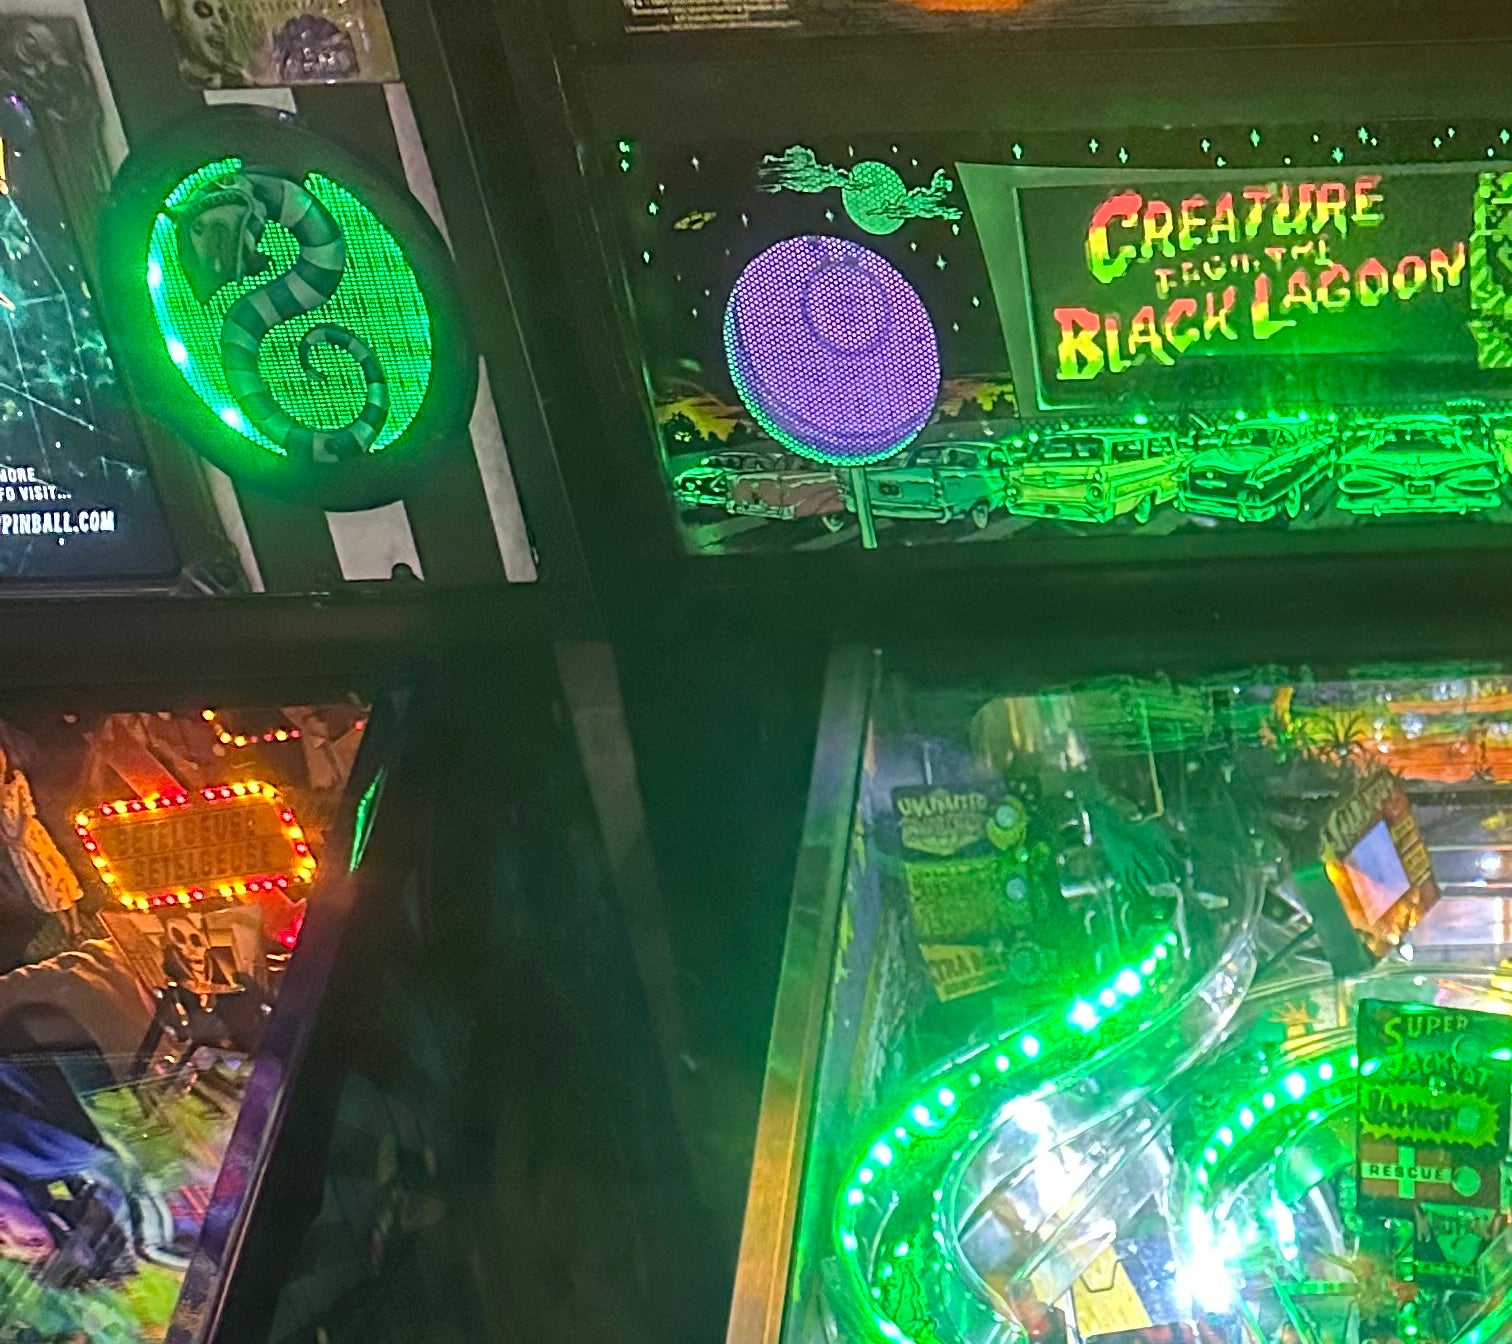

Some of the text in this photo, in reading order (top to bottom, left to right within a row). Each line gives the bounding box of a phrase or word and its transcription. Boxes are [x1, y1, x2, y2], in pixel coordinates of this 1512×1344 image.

[1086, 175, 1384, 283] CREATURE
[1053, 241, 1466, 381] BLACK LAGOON
[0, 510, 115, 535] PINBALL.COM
[1384, 1013, 1470, 1054] SUPER
[1368, 1162, 1446, 1181] RESCUE
